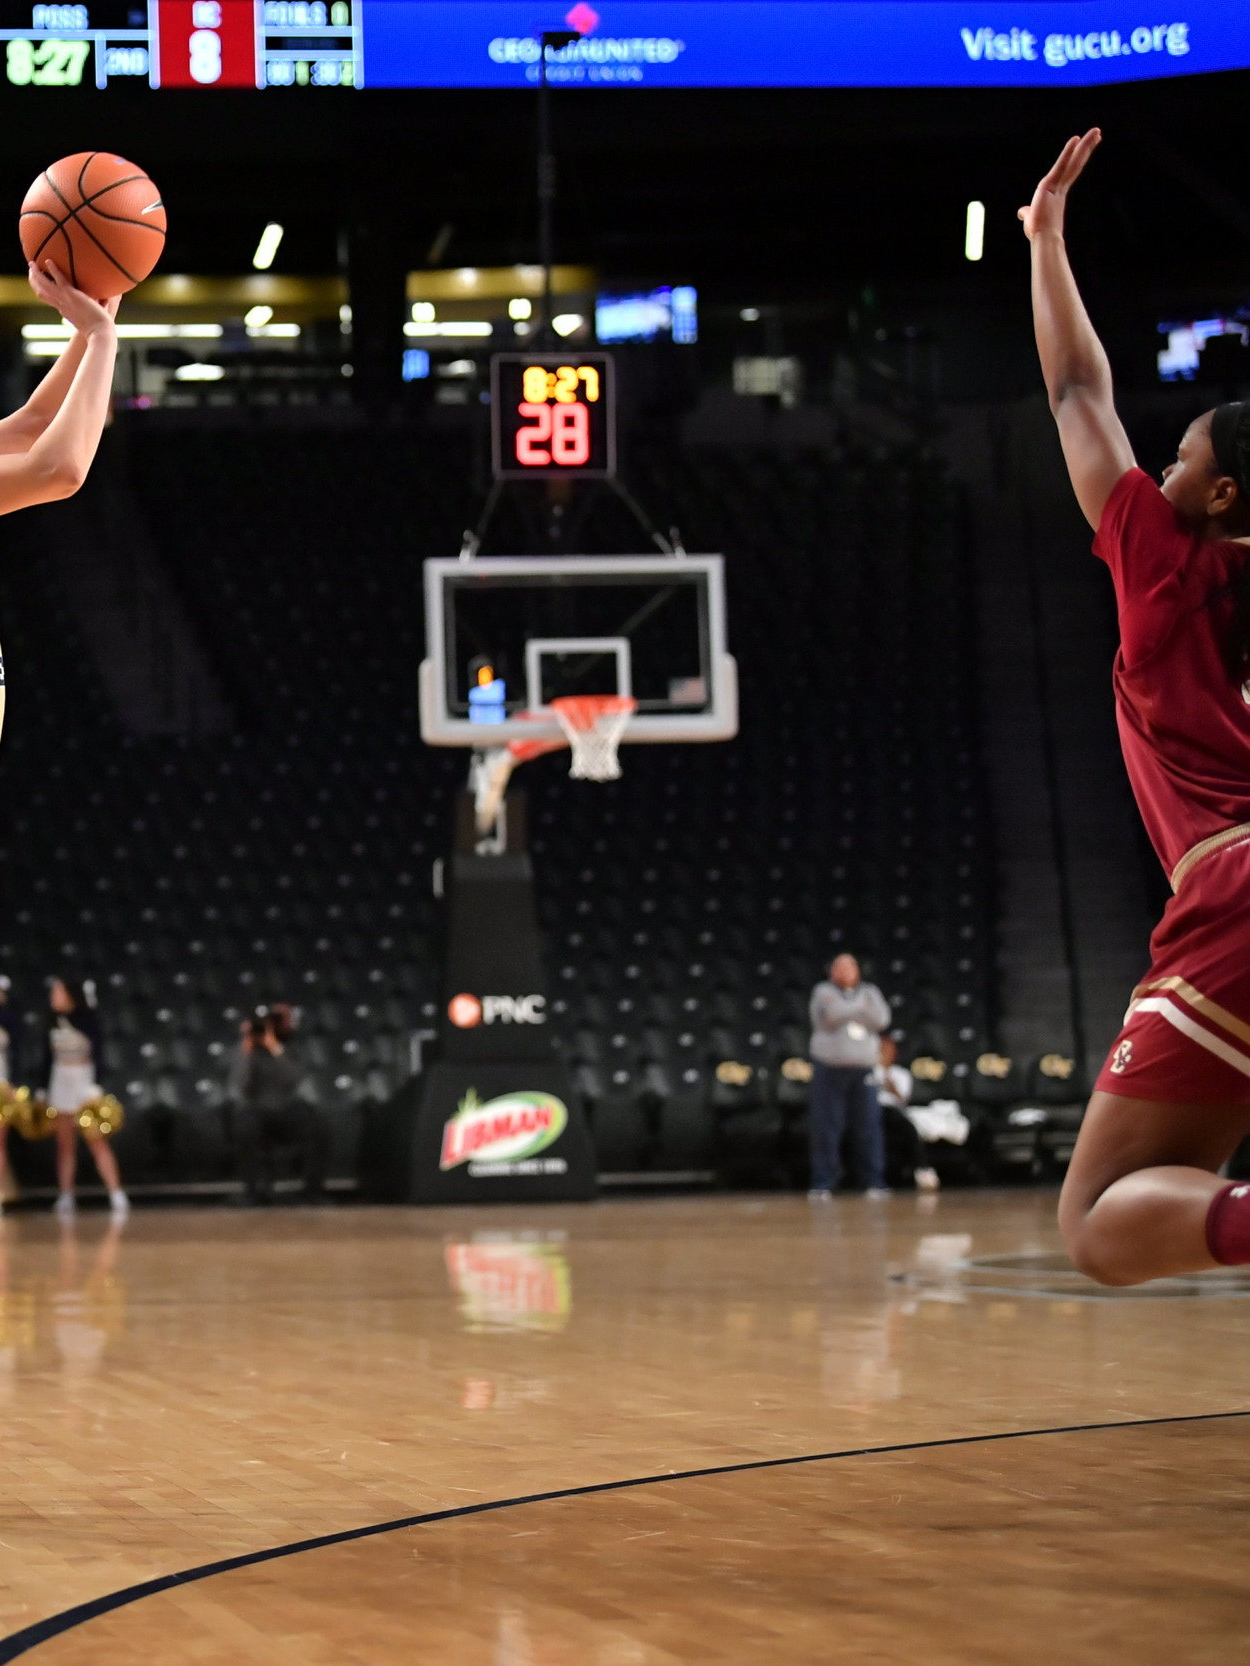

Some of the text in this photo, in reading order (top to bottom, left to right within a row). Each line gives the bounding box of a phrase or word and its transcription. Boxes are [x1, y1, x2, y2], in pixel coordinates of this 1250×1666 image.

[189, 29, 222, 84] 8
[960, 22, 1190, 67] Visit gucu.org
[523, 366, 599, 403] 8:27
[516, 402, 590, 465] 28
[482, 994, 547, 1025] PNC
